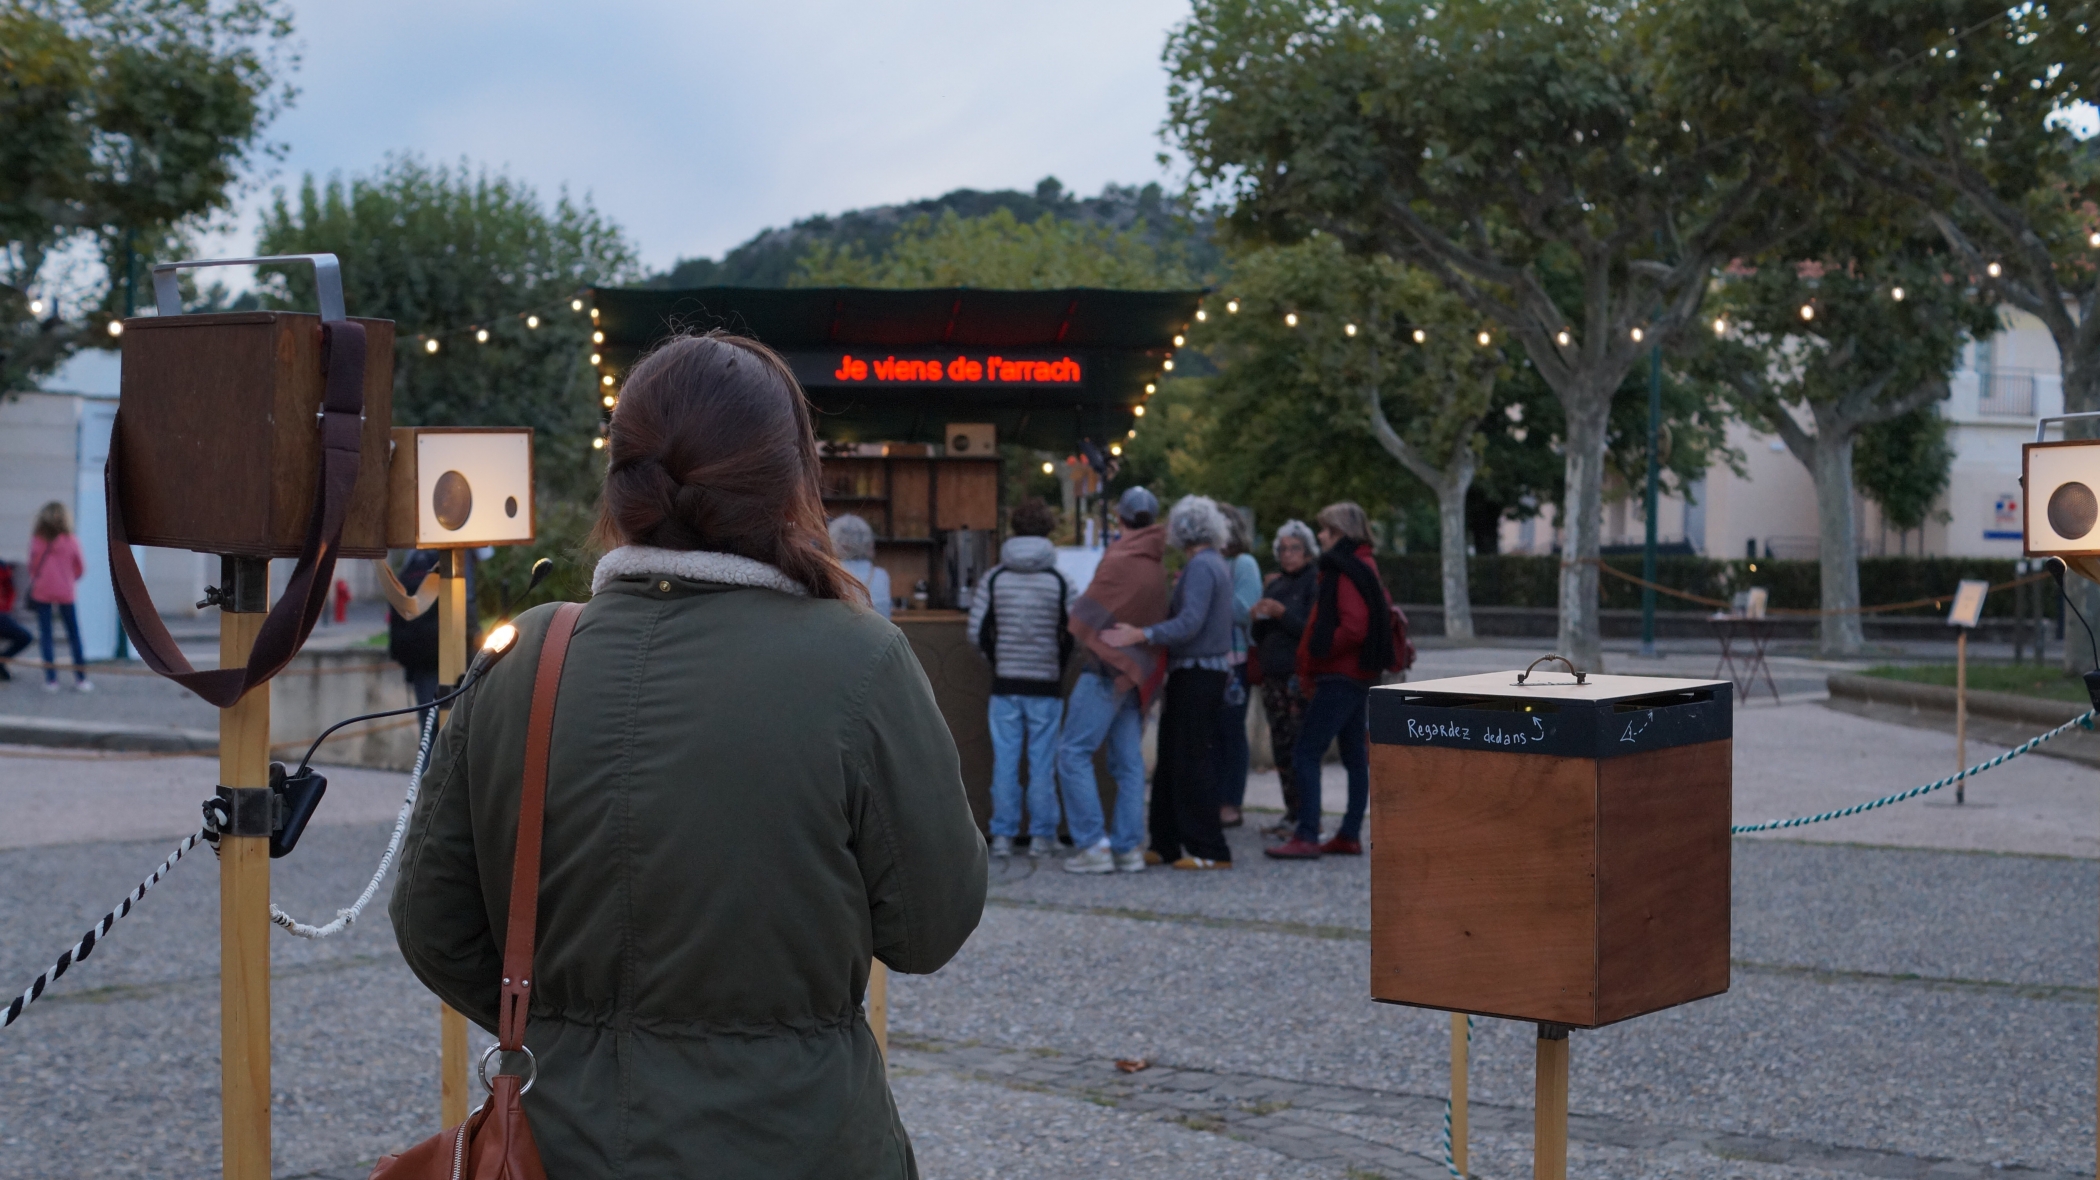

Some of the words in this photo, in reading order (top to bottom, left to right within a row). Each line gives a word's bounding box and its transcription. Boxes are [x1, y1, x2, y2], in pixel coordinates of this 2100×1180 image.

[835, 354, 868, 381] Je
[873, 355, 943, 382] viens
[947, 355, 982, 382] de
[987, 355, 1080, 382] l'arrach
[1483, 726, 1527, 745] dedans
